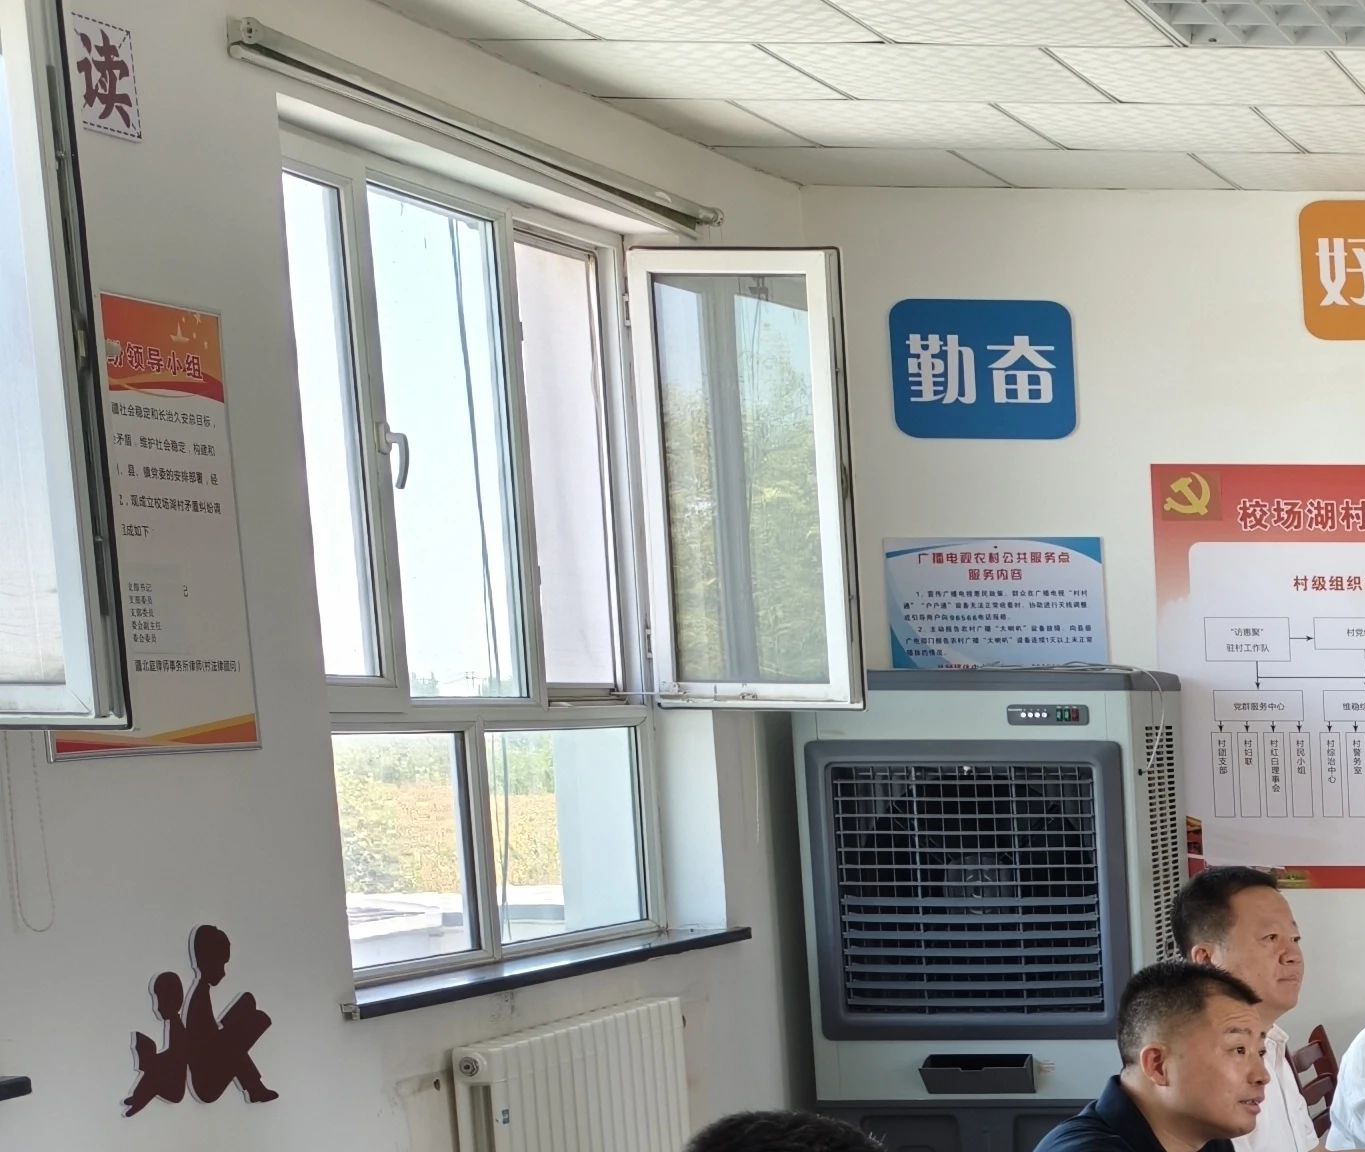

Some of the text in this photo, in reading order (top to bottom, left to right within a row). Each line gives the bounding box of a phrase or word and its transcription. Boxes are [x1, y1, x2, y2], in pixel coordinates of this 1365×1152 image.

[74, 28, 133, 129] 读
[906, 334, 1056, 404] 勤奋
[113, 432, 215, 457] 矛盾，维护社会稳定，构建和
[917, 551, 1071, 565] 广播电视农村公共服务点
[968, 568, 1023, 581] 服务内容
[1226, 643, 1270, 653] 驻村工作队
[1233, 702, 1285, 711] 党群服务中心
[1217, 739, 1228, 775] 村团支部
[1243, 739, 1253, 766] 村妇联
[1296, 739, 1306, 775] 村民小组
[1326, 739, 1337, 784] 村综治中心
[1352, 739, 1363, 775] 村警务室
